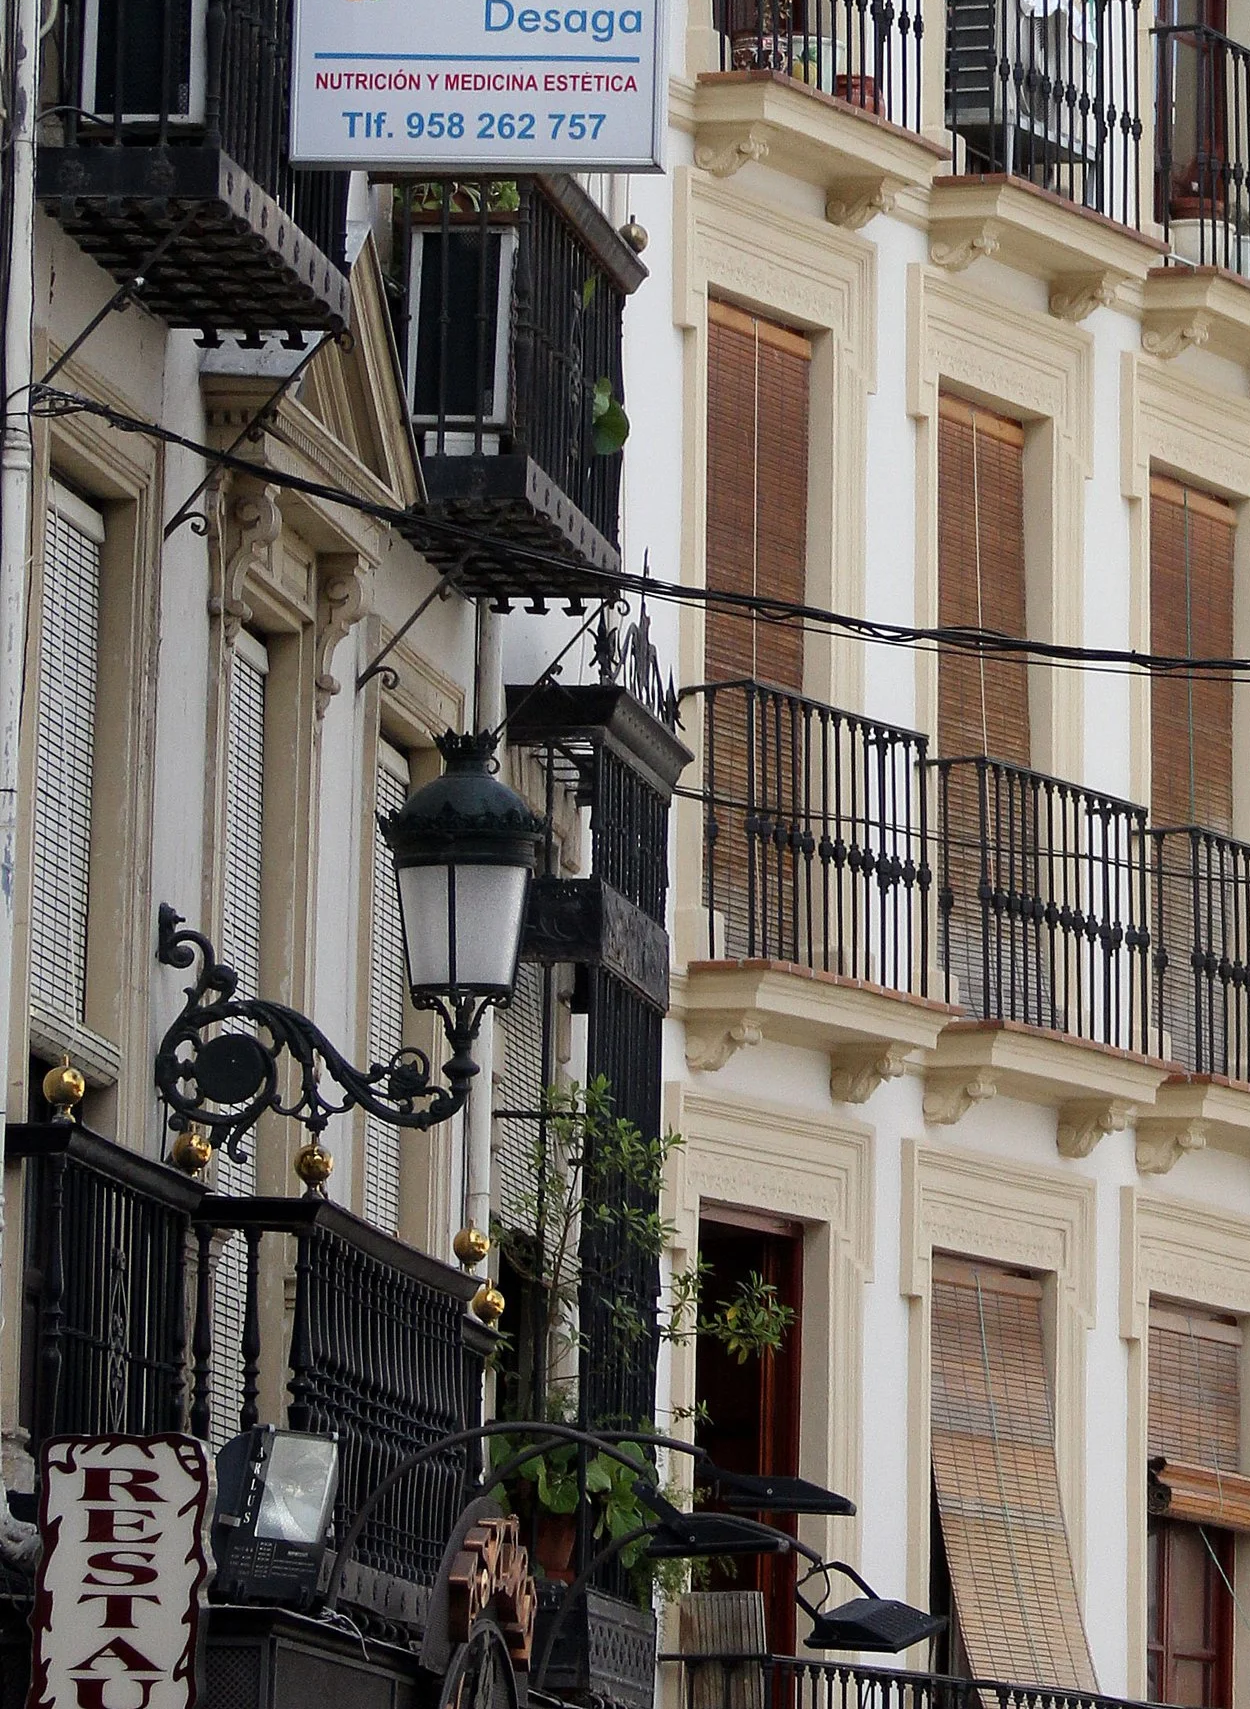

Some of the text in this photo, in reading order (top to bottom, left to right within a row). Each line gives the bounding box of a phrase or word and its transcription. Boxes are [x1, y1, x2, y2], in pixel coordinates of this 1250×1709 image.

[315, 69, 638, 93] NUTRICIÓN Y MEDICINA ESTÉTICA
[342, 111, 607, 140] Tlf. 958 262 757
